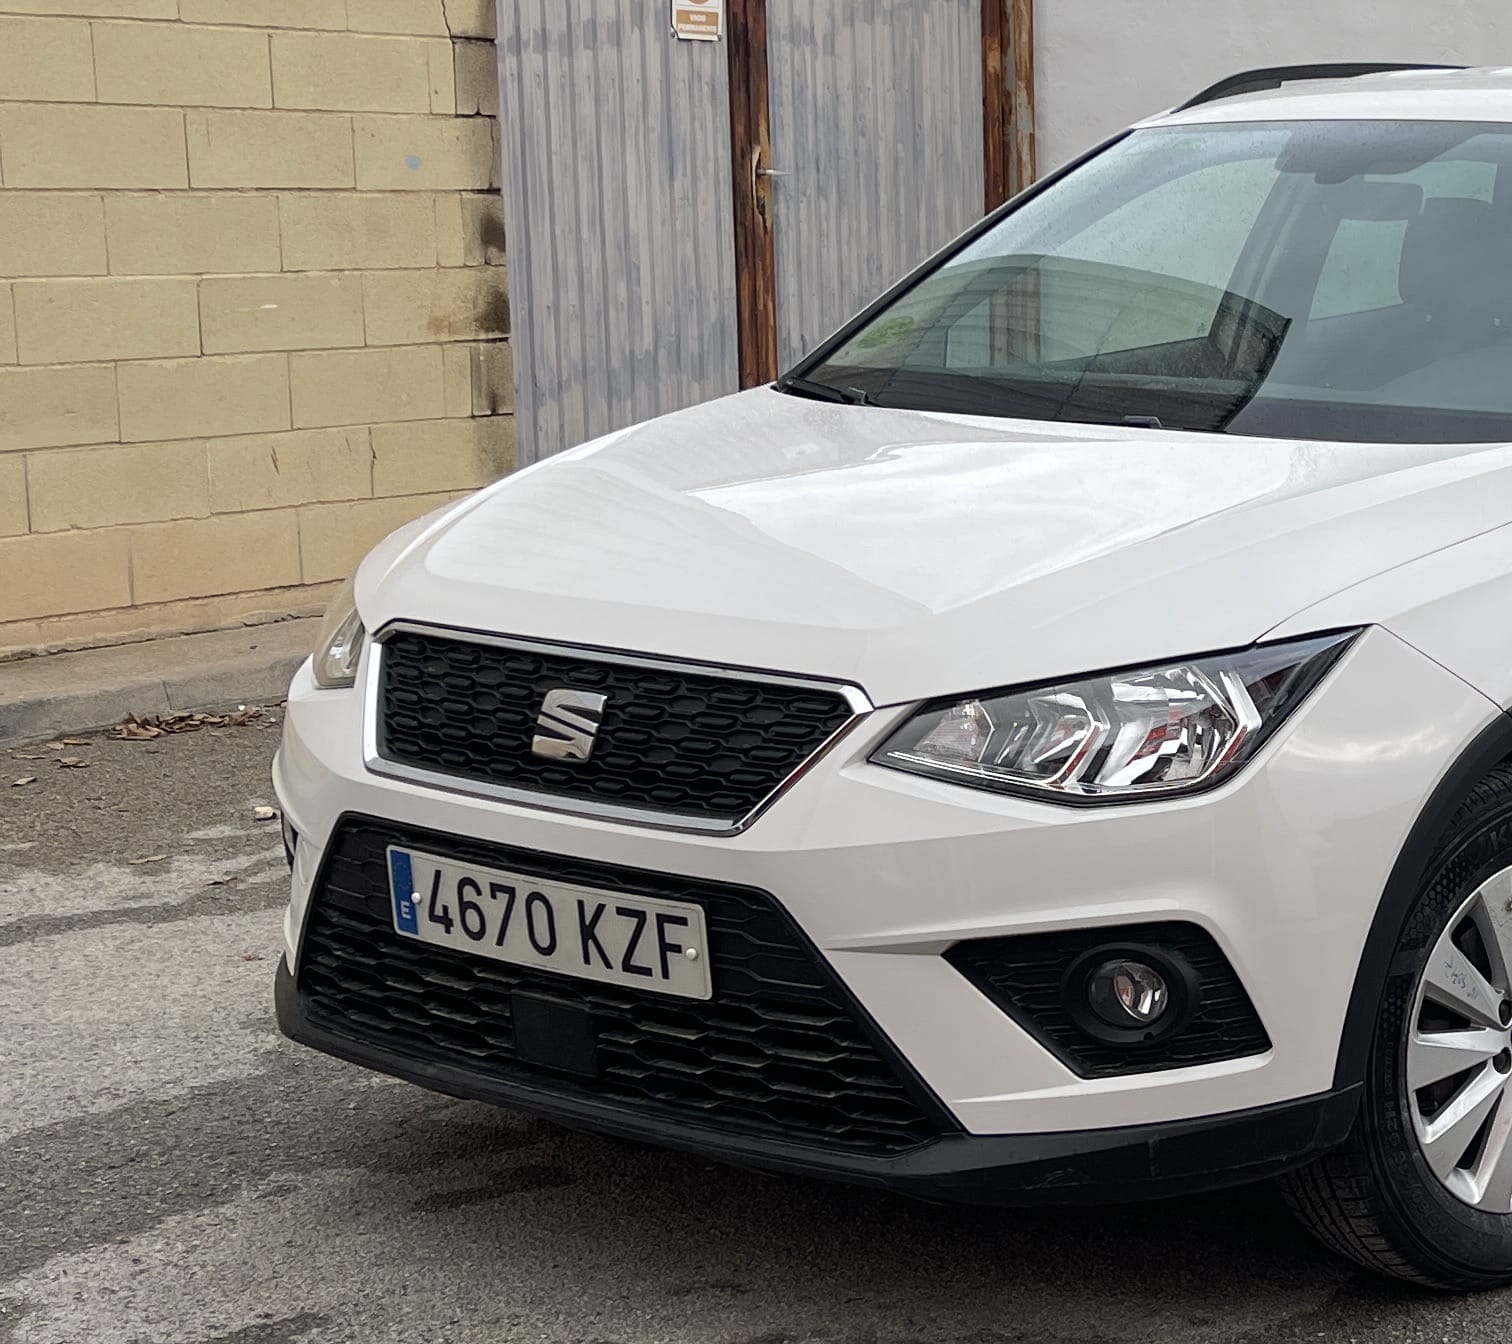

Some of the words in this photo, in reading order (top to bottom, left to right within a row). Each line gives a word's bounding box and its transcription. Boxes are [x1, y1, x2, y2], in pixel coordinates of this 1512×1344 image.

[400, 900, 412, 920] E
[427, 869, 558, 957] 4670
[577, 901, 689, 981] KZF
